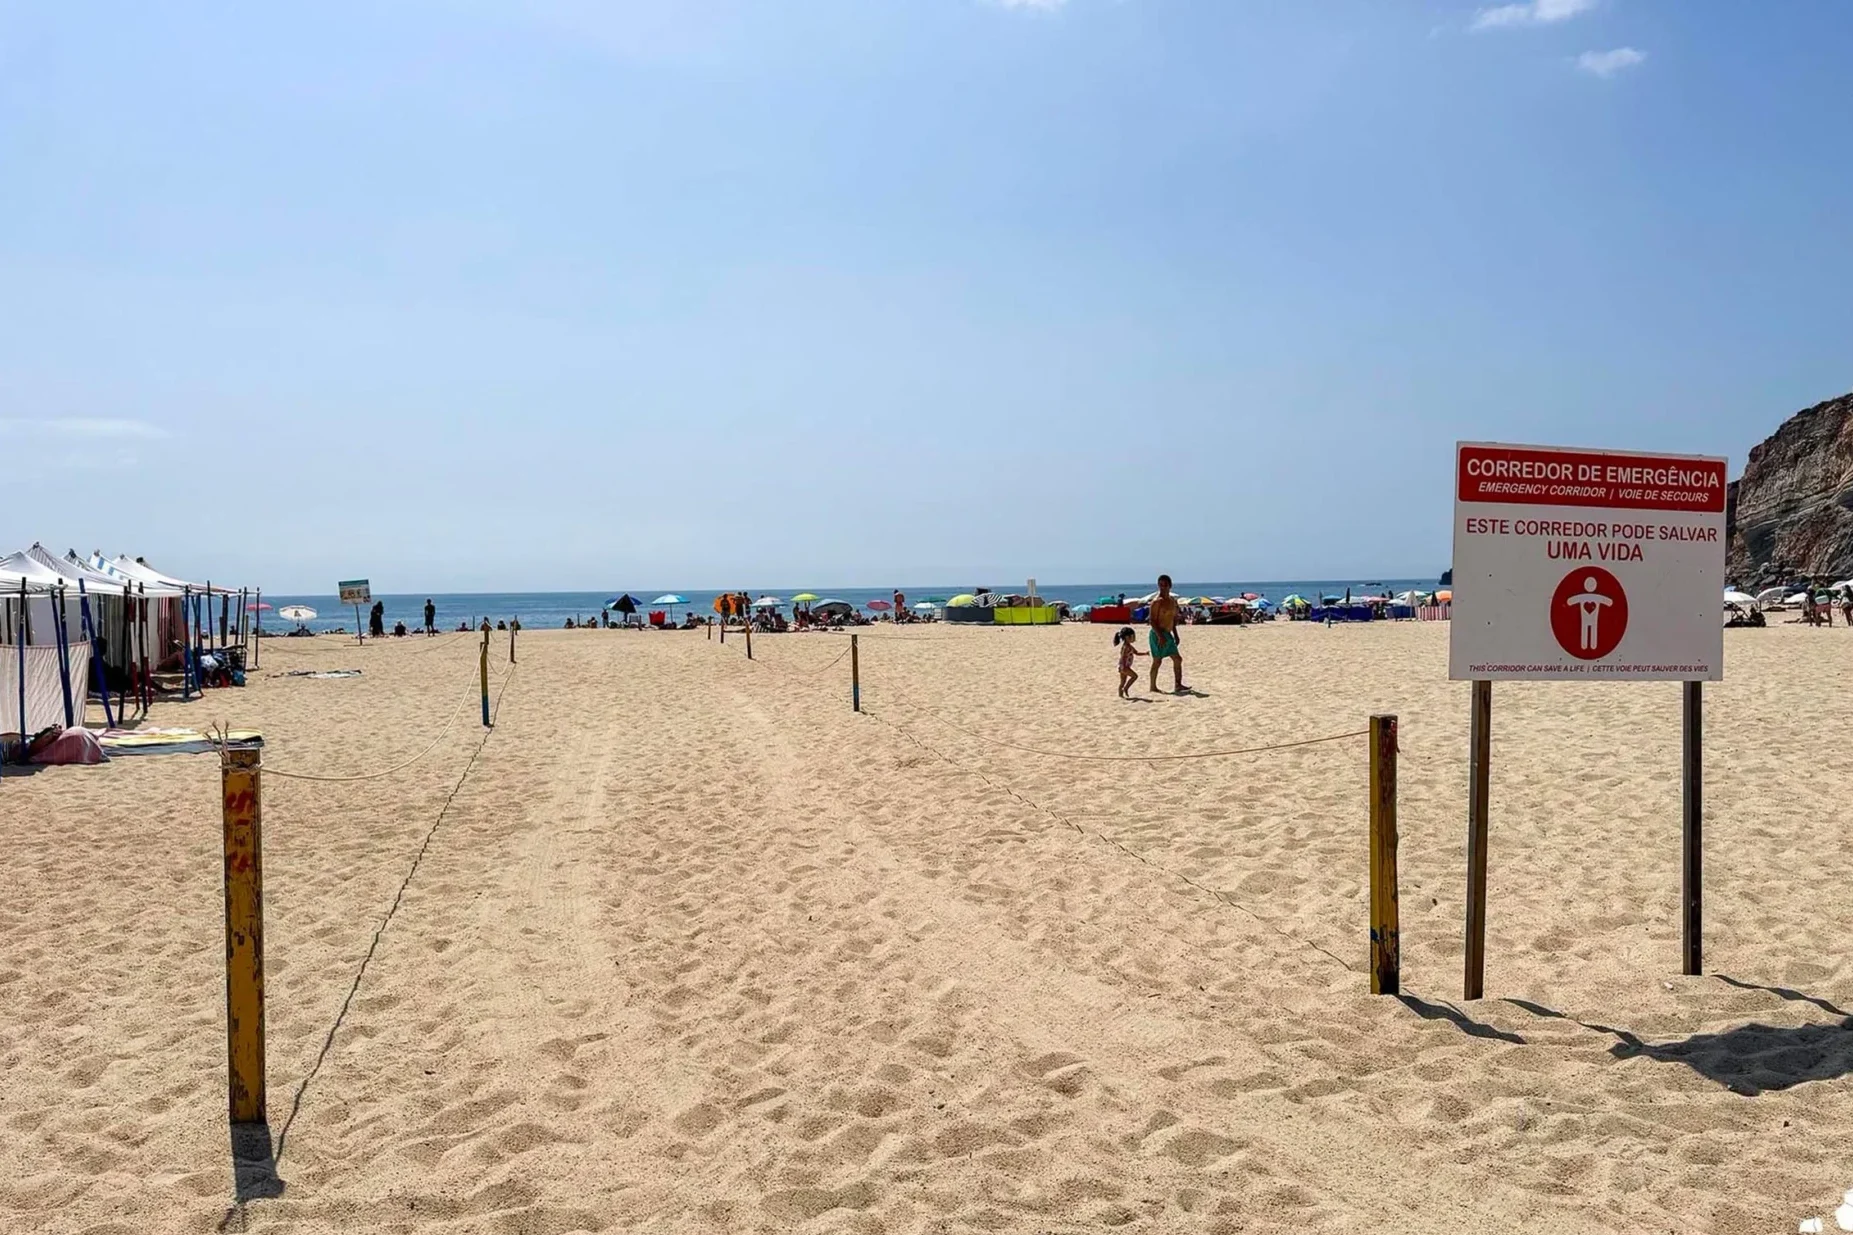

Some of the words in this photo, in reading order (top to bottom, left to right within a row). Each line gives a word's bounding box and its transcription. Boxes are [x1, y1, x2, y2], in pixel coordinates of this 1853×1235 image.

[1467, 458, 1573, 480] CORREDOR
[1578, 464, 1602, 482] DE
[1606, 465, 1720, 488] EMERGÊNCIA
[1478, 481, 1548, 495] EMERGENCY
[1549, 484, 1607, 498] CORRIDOR
[1618, 488, 1643, 500] VOIE
[1644, 489, 1659, 501] DE
[1660, 490, 1710, 503] SECOURS
[1466, 518, 1510, 535] ESTE
[1514, 519, 1608, 538] CORREDOR
[1612, 523, 1655, 540] PODE
[1658, 525, 1718, 542] SALVAR
[1547, 540, 1592, 560] UMA
[1597, 542, 1644, 562] VIDA
[1469, 664, 1486, 673] THIS
[1486, 664, 1527, 673] CORRIDOR
[1527, 664, 1543, 673] CAN
[1543, 664, 1562, 673] SAVE
[1563, 664, 1570, 673] A
[1570, 664, 1585, 673] LIFE
[1592, 664, 1615, 673] CETTE
[1616, 664, 1633, 673] VOIE
[1633, 664, 1651, 673] PEUT
[1651, 664, 1679, 673] SAUVER
[1679, 664, 1693, 673] DES
[1693, 664, 1709, 673] VIES
